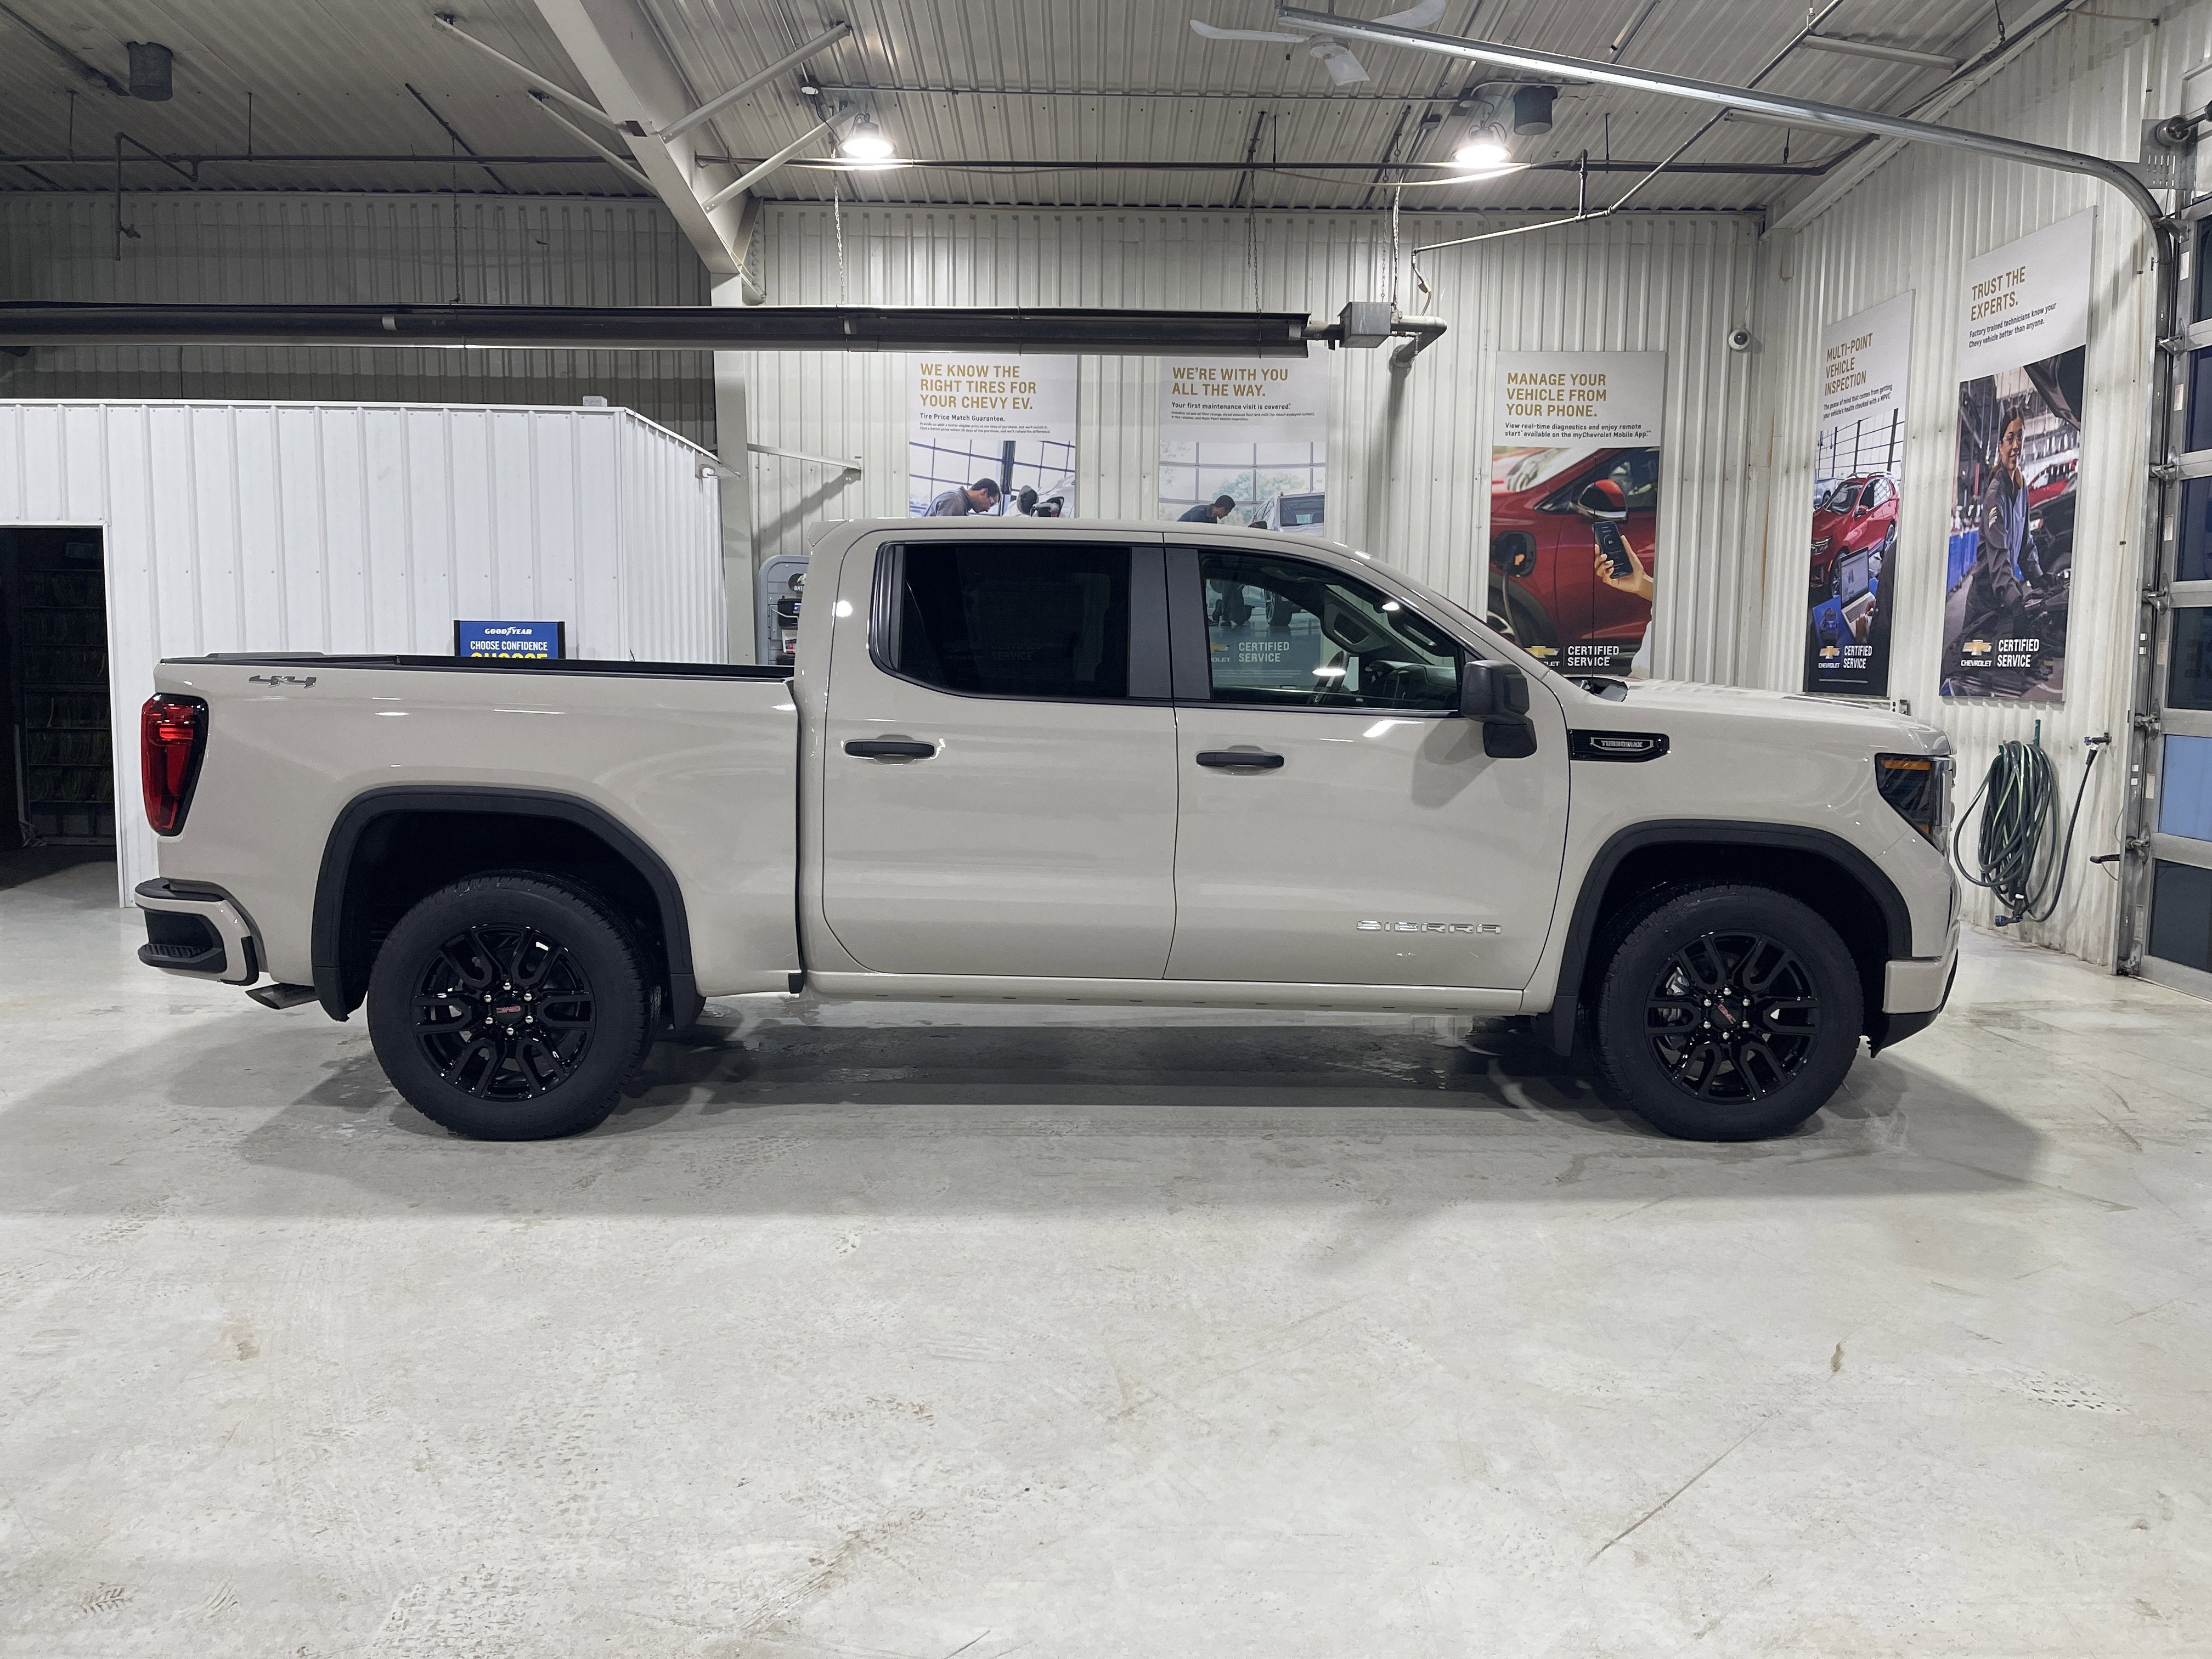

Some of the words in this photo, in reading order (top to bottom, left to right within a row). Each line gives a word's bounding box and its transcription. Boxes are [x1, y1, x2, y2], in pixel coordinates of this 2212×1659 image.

[1972, 275, 2003, 301] TRUST
[2006, 266, 2025, 287] THE
[1971, 291, 2018, 321] EXPERTS.
[1970, 328, 1986, 338] Factory
[1987, 321, 2002, 332] trained
[2004, 313, 2030, 327] technicians
[2032, 307, 2044, 317] know
[2045, 303, 2057, 314] your
[1969, 340, 1982, 348] Chevy
[1983, 334, 1998, 344] vehicle
[1999, 329, 2013, 339] better
[2015, 325, 2025, 334] than
[2027, 318, 2044, 330] anyone.
[1826, 332, 1873, 362] MULTI-POINT
[921, 363, 942, 376] WE
[947, 364, 989, 377] KNOW
[994, 365, 1020, 378] THE
[1172, 367, 1216, 380] WE'RE
[1221, 368, 1256, 381] WITH
[1261, 369, 1288, 381] YOU
[1826, 357, 1855, 379] VEHICLE
[921, 379, 962, 392] RIGHT
[966, 381, 1006, 393] TIRES
[1011, 381, 1036, 394] FOR
[1508, 373, 1565, 386] MANAGE
[1570, 374, 1606, 386] YOUR
[1825, 370, 1867, 396] INSPECTION
[1172, 383, 1198, 396] ALL
[1202, 383, 1228, 396] THE
[1233, 385, 1266, 397] WAY.
[1507, 388, 1564, 401] VEHICLE
[1569, 389, 1606, 402] FROM
[920, 394, 957, 408] YOUR
[962, 396, 1008, 409] CHEVY
[1013, 397, 1032, 409] EV.
[1506, 403, 1542, 416] YOUR
[1548, 405, 1597, 417] PHONE.
[484, 627, 532, 636] GOODYEAR
[470, 641, 499, 650] CHOOSE
[501, 641, 548, 651] CONFIDENCE
[1239, 641, 1289, 651] CERTIFIED
[1568, 646, 1619, 656] CERTIFIED
[1844, 645, 1872, 656] CERTIFIED
[1999, 639, 2039, 652] CERTIFIED
[1239, 653, 1280, 662] SERVICE
[1567, 657, 1610, 667] SERVICE
[1843, 658, 1866, 669] SERVICE
[1997, 654, 2031, 667] SERVICE
[1357, 920, 1502, 933] SIERRA
[496, 1005, 521, 1014] GMC
[1718, 1004, 1736, 1024] GMC
